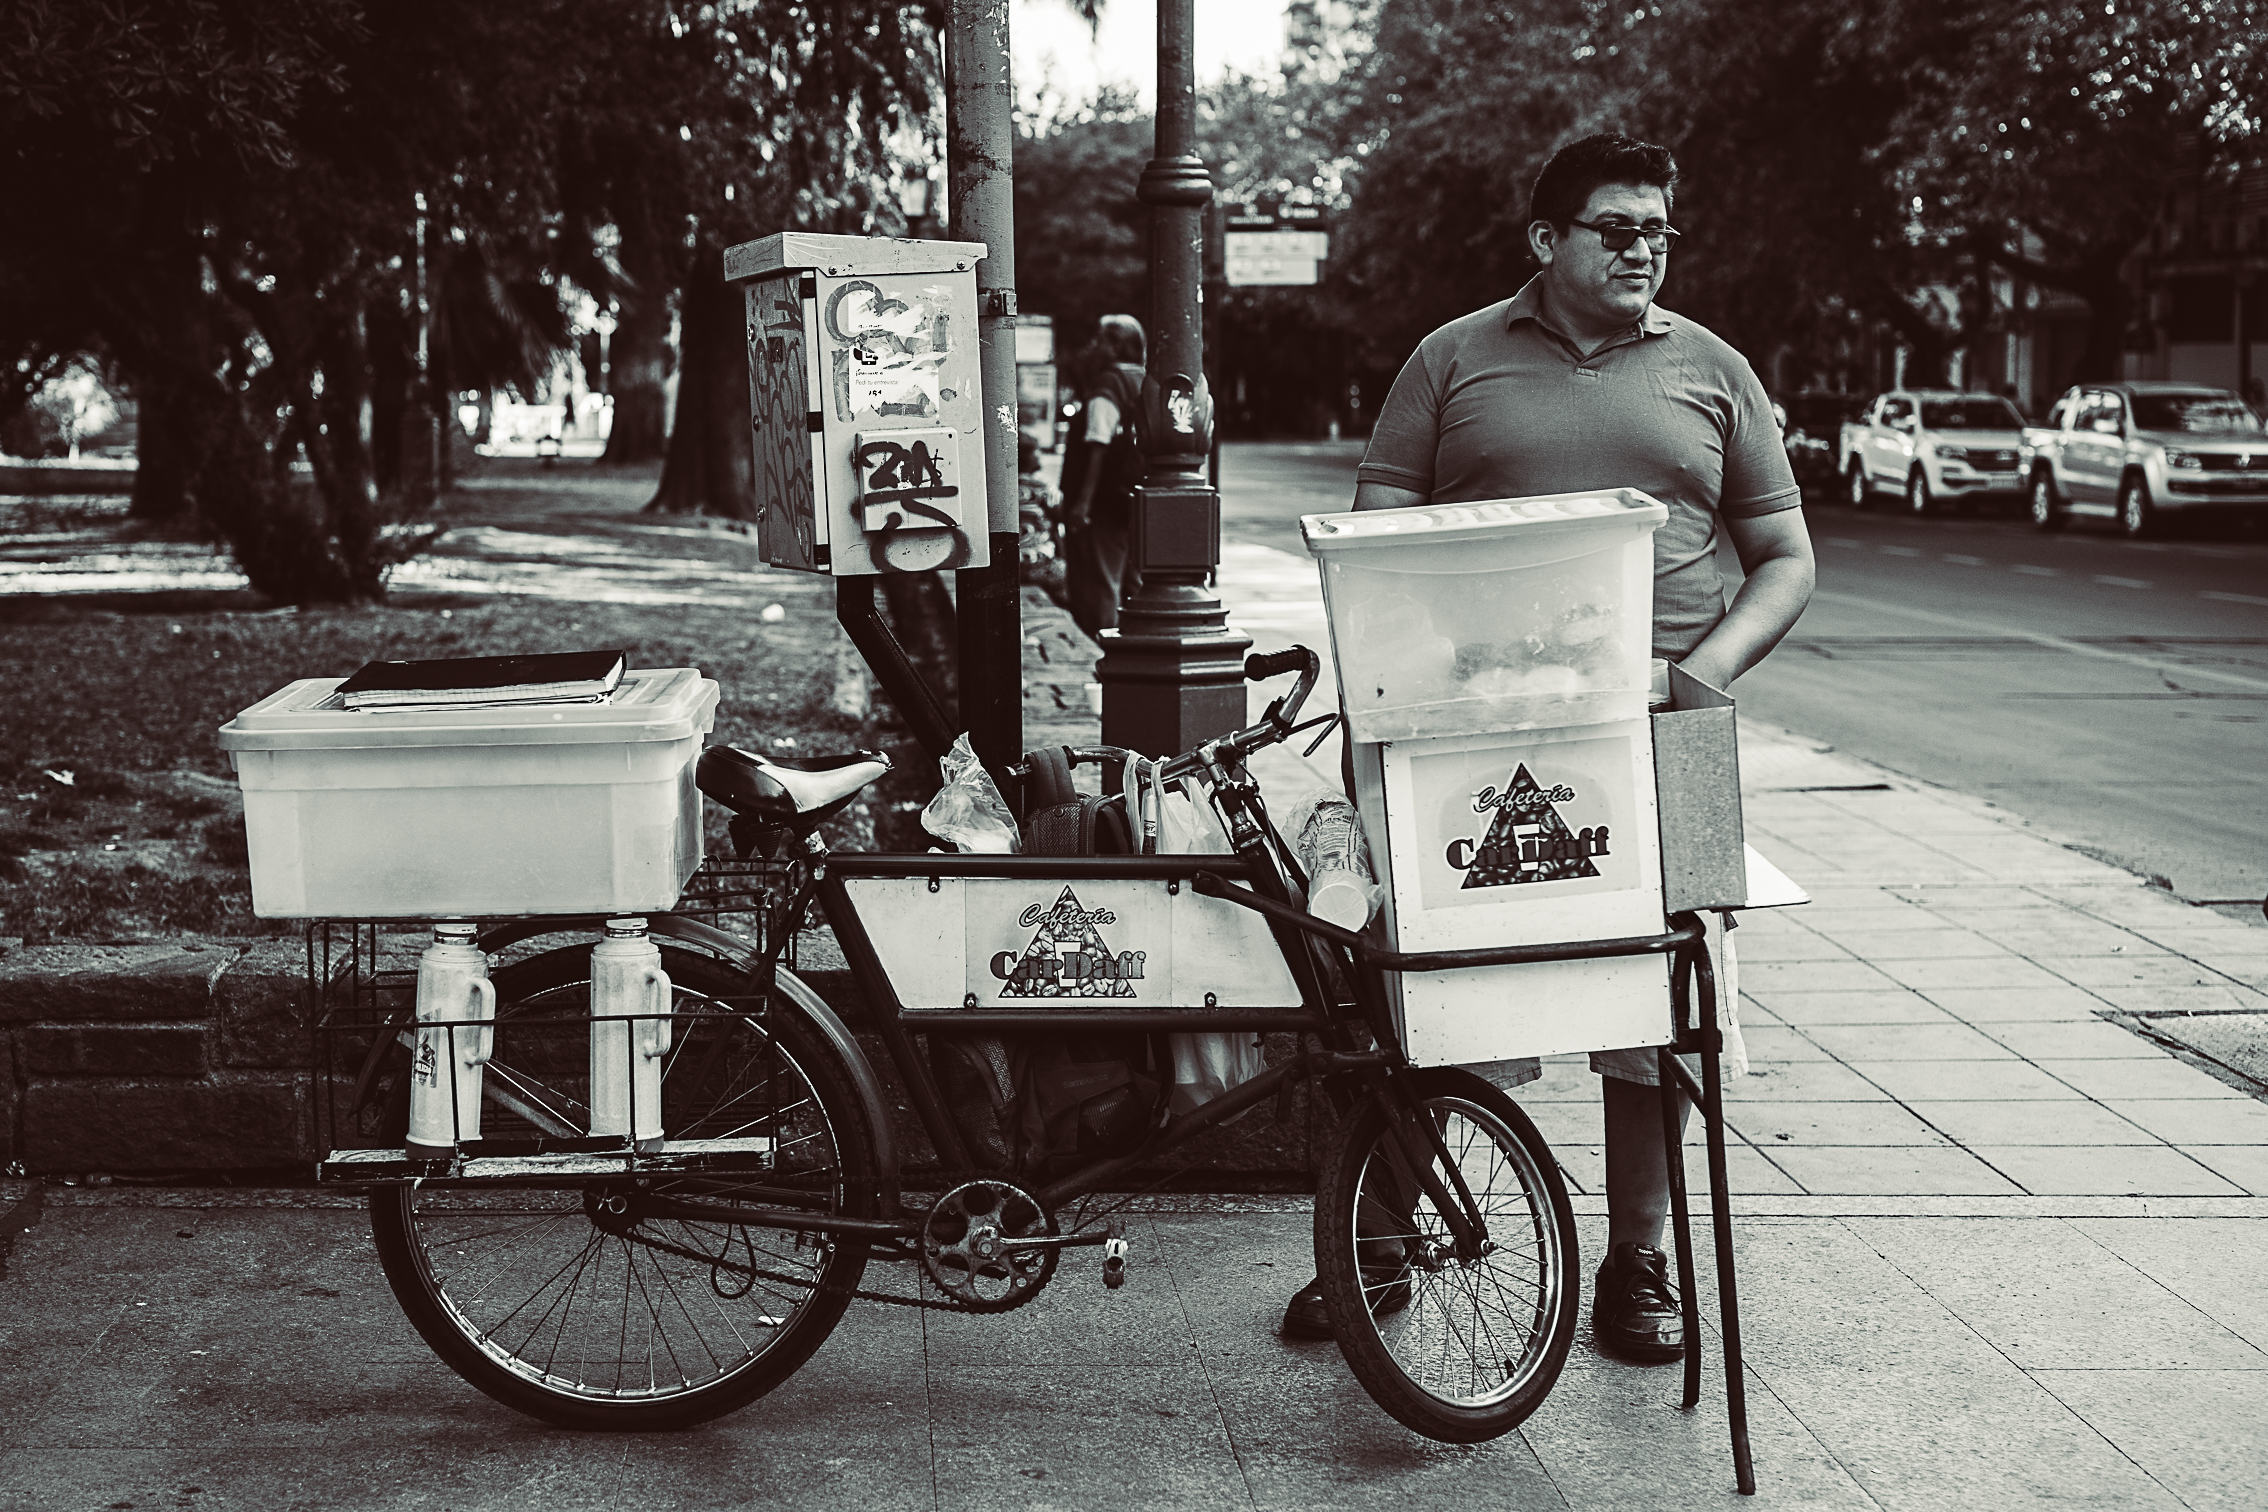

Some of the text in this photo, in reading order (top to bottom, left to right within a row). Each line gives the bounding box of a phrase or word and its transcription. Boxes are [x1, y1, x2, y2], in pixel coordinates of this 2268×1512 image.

[1473, 784, 1575, 812] Cafetería
[1019, 903, 1117, 929] Cafetería
[990, 951, 1147, 980] CarDaff
